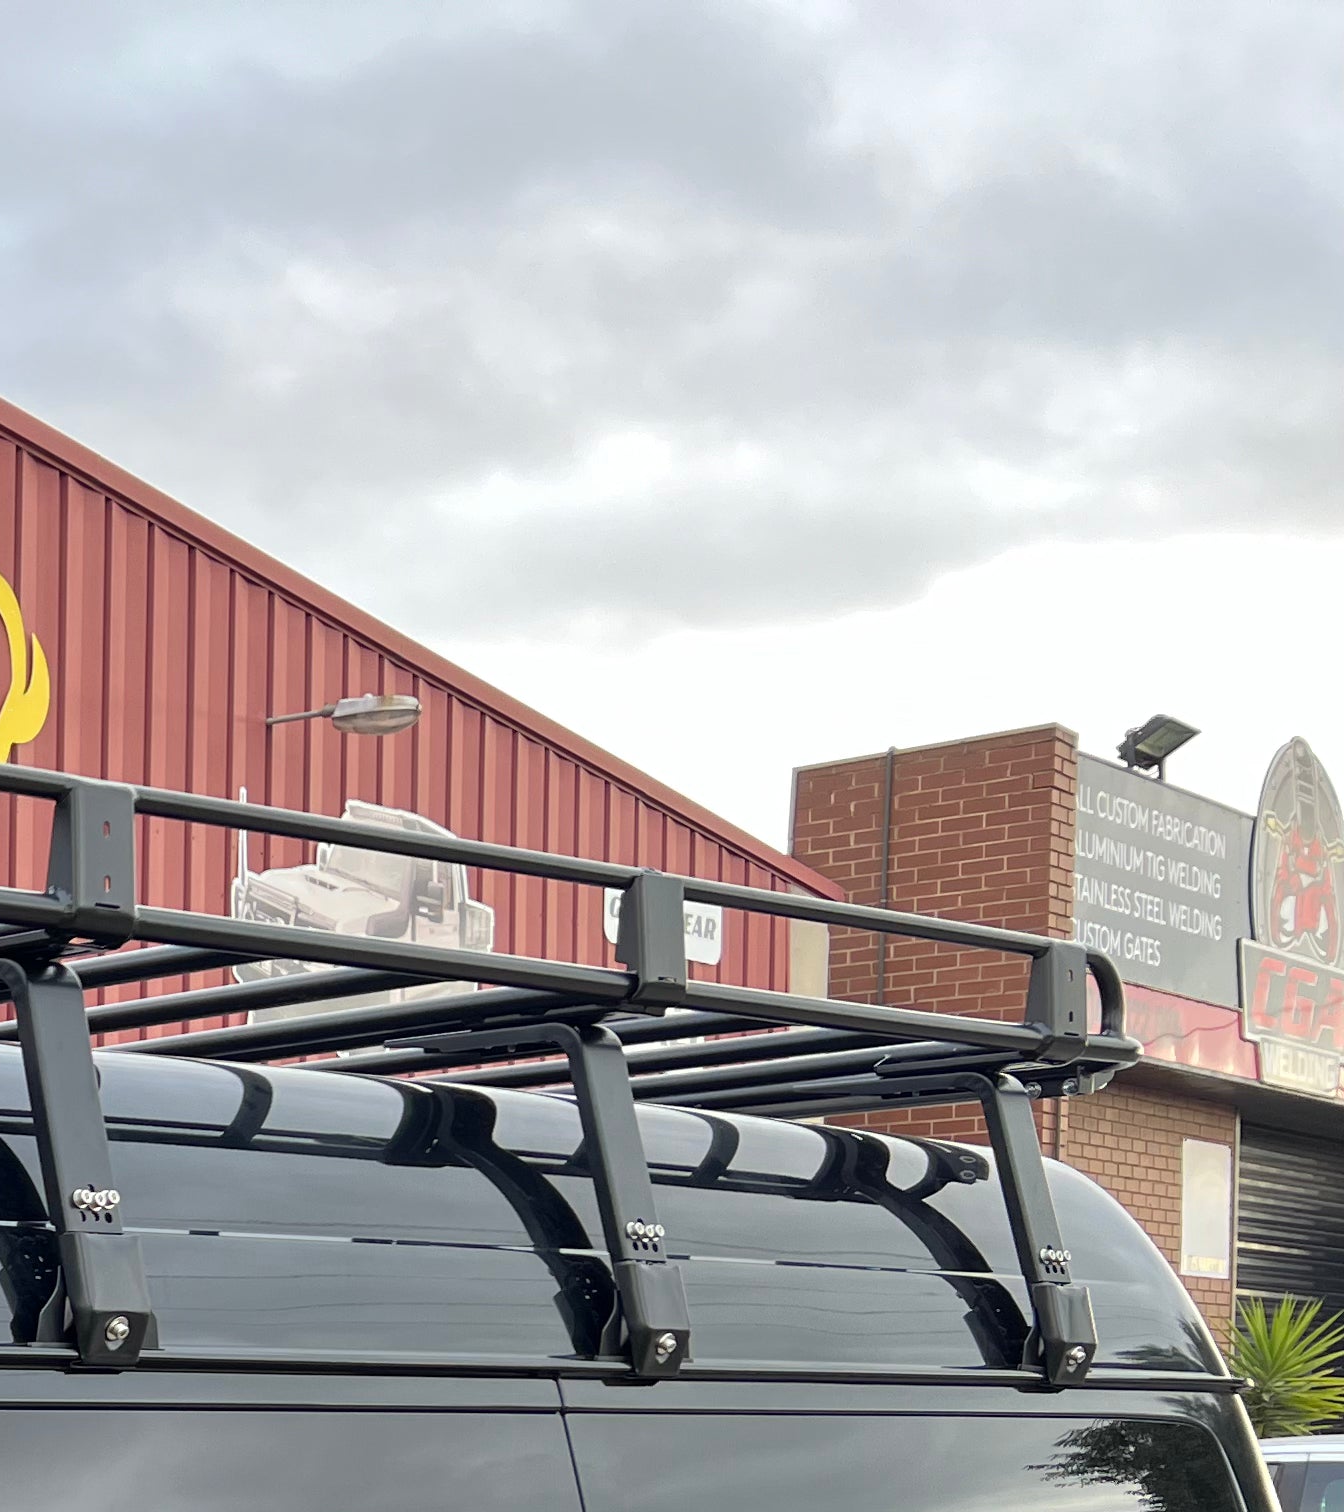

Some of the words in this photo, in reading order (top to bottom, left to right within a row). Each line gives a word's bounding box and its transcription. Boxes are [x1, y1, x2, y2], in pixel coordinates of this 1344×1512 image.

[1097, 790, 1149, 833] CUSTOM
[1152, 810, 1225, 860] FABRICATION
[1146, 852, 1166, 881] TIG
[1168, 858, 1221, 899] WELDING
[1072, 873, 1131, 916] TAINLESS
[1134, 891, 1167, 926] STEEL
[1169, 901, 1223, 941] WELDING
[1124, 932, 1162, 967] GATES
